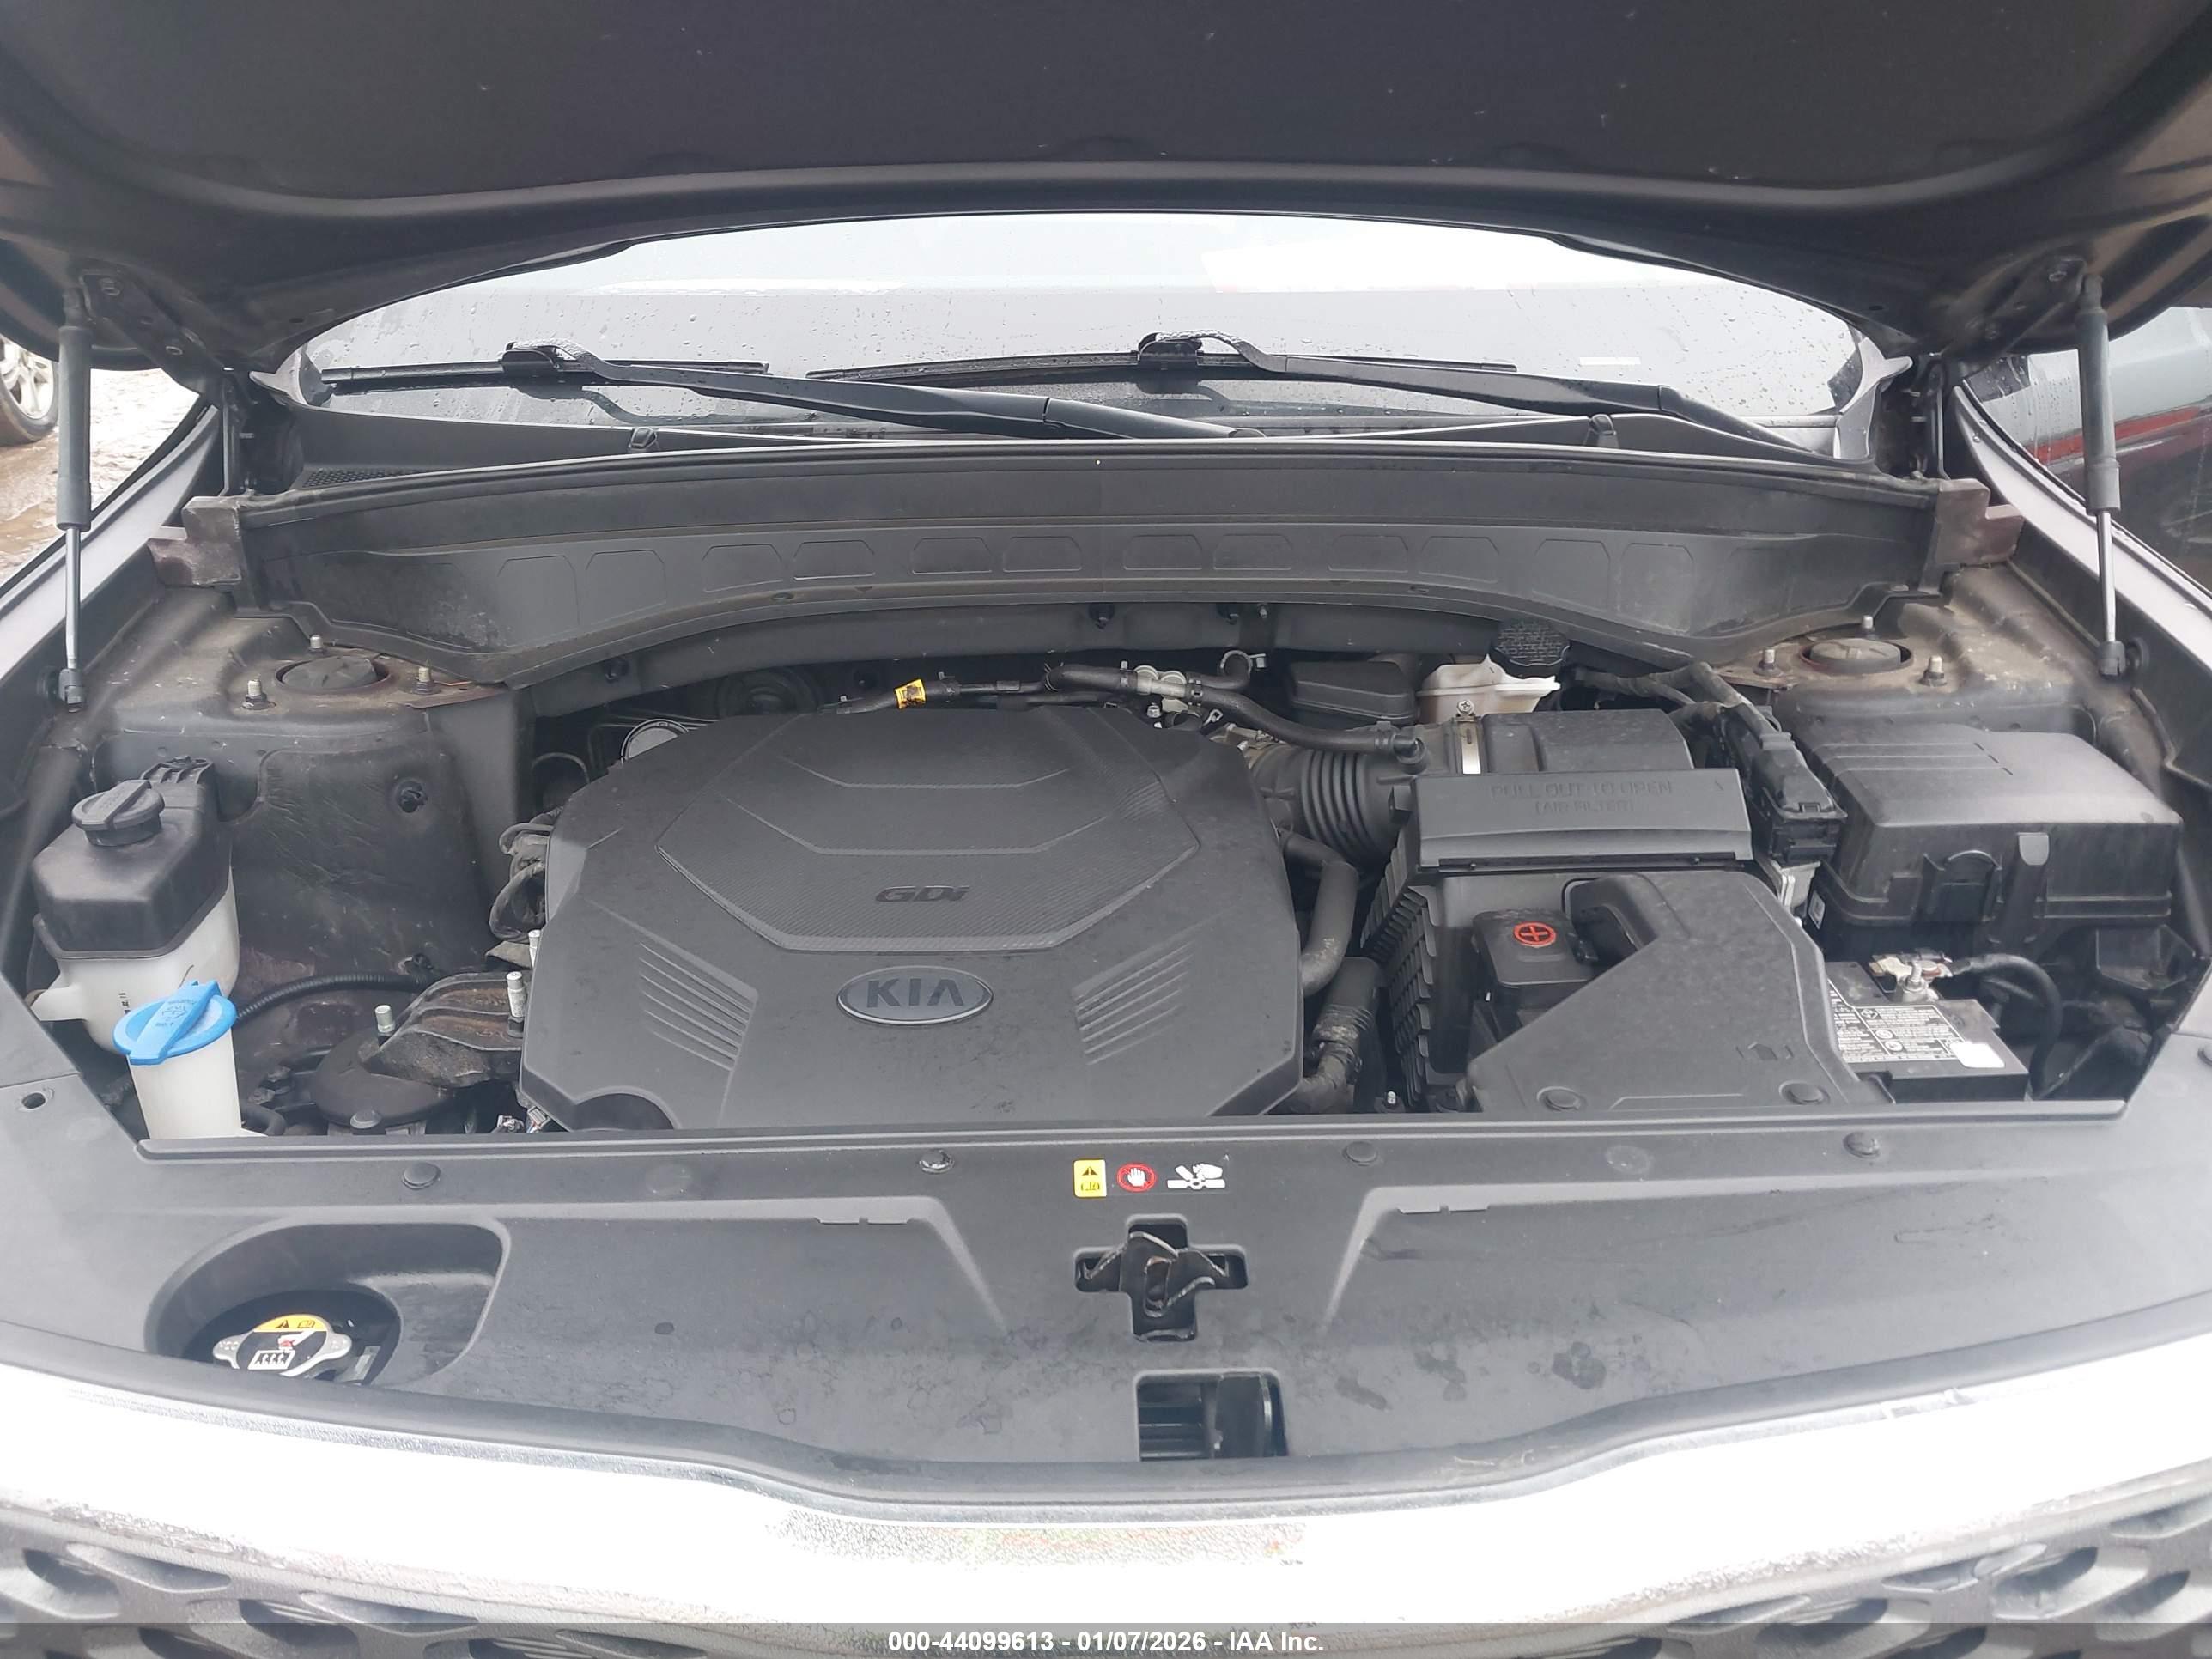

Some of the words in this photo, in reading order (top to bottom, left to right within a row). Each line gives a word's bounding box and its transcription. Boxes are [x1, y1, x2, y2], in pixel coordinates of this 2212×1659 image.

[1490, 782, 1540, 799] PULL
[1544, 782, 1584, 798] OUT
[1589, 781, 1614, 797] TO
[1618, 780, 1672, 797] OPEN
[866, 978, 964, 1008] KIA
